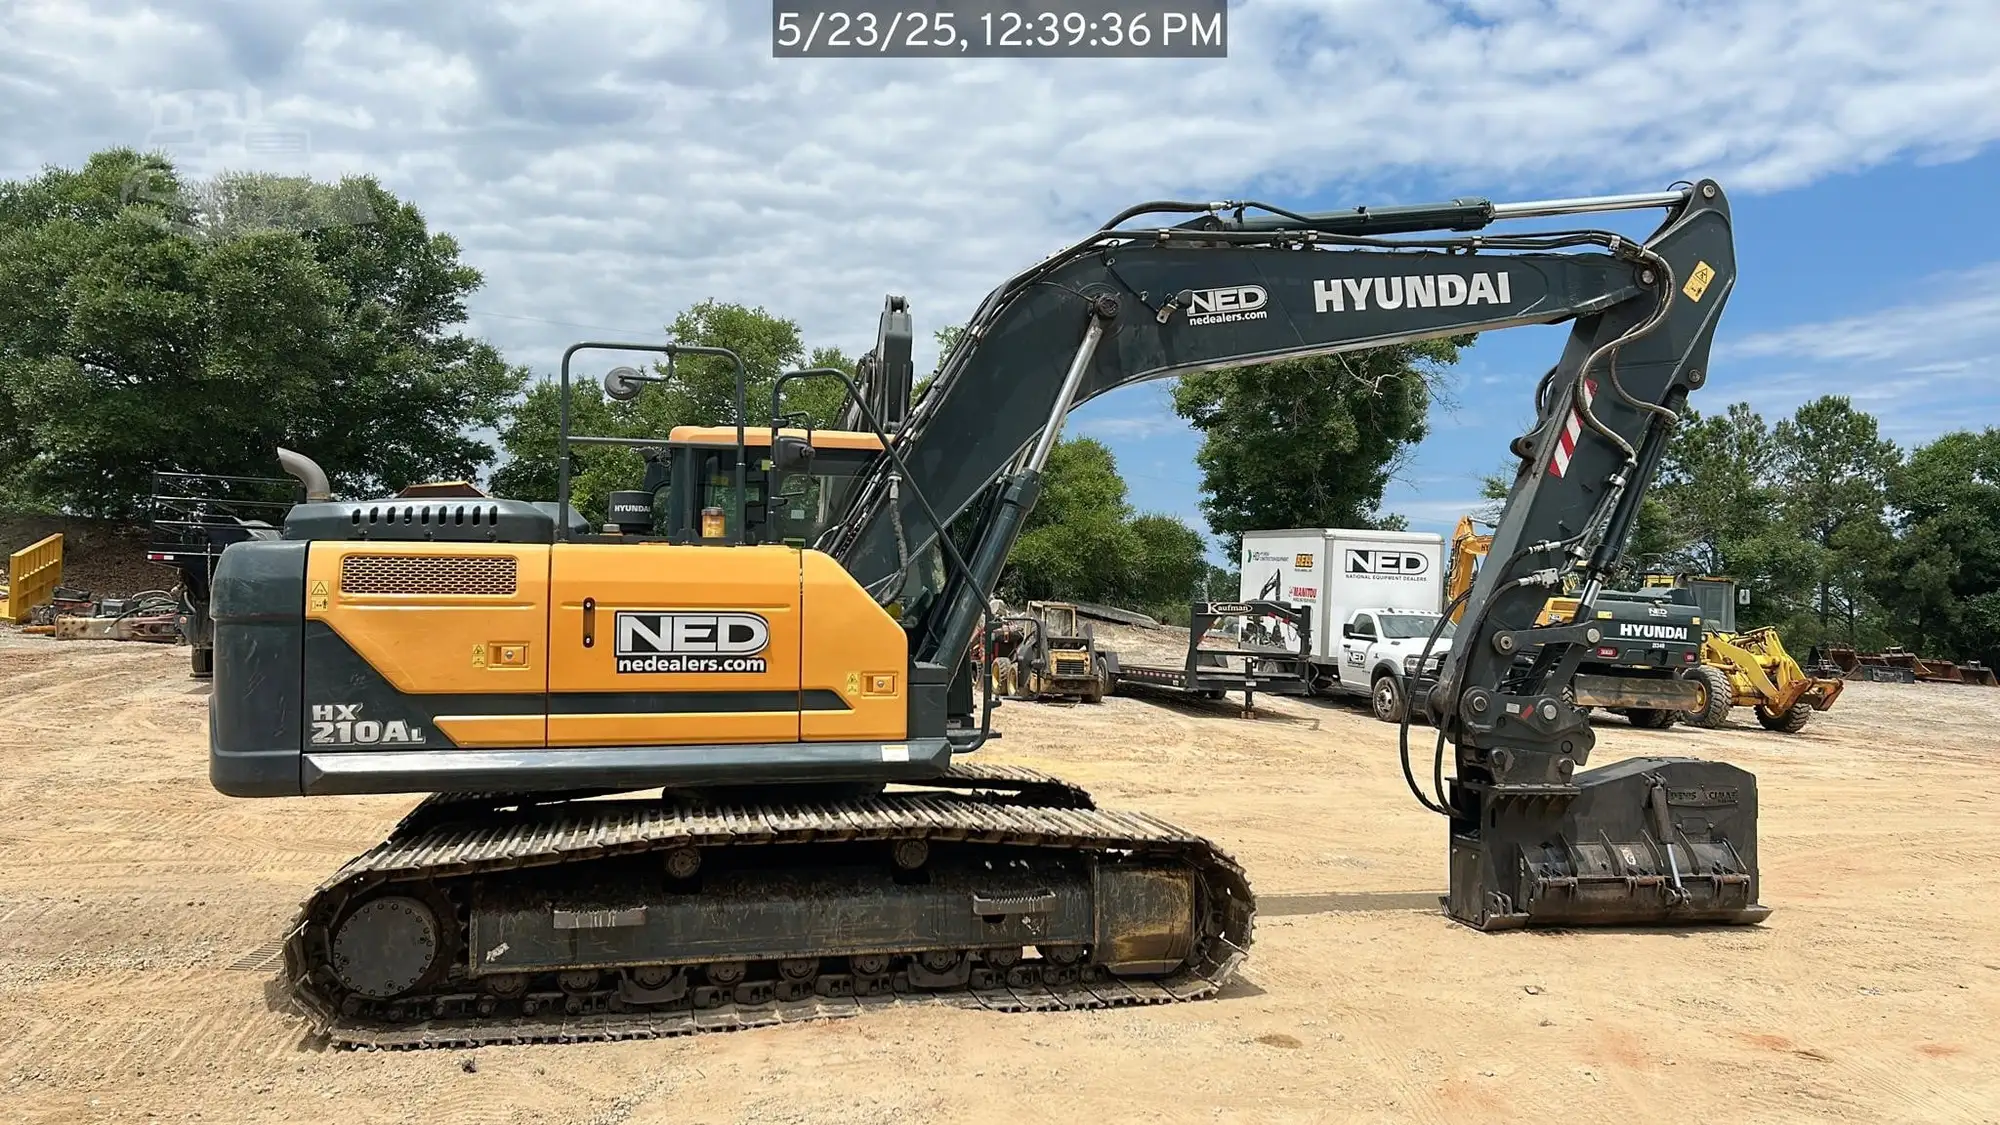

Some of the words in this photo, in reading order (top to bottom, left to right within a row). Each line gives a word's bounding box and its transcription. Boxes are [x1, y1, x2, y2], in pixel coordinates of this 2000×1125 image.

[1190, 286, 1266, 314] NED
[1313, 272, 1512, 313] HYUNDAI
[1189, 310, 1268, 326] nedealers.com
[1346, 550, 1429, 574] NED
[1293, 587, 1317, 598] MANITOU
[1207, 602, 1249, 615] Kaufman
[619, 616, 769, 652] NED
[1620, 623, 1688, 640] HYUNDAI
[618, 656, 765, 672] nedealers.com
[1347, 650, 1366, 665] NED
[312, 703, 361, 721] HX
